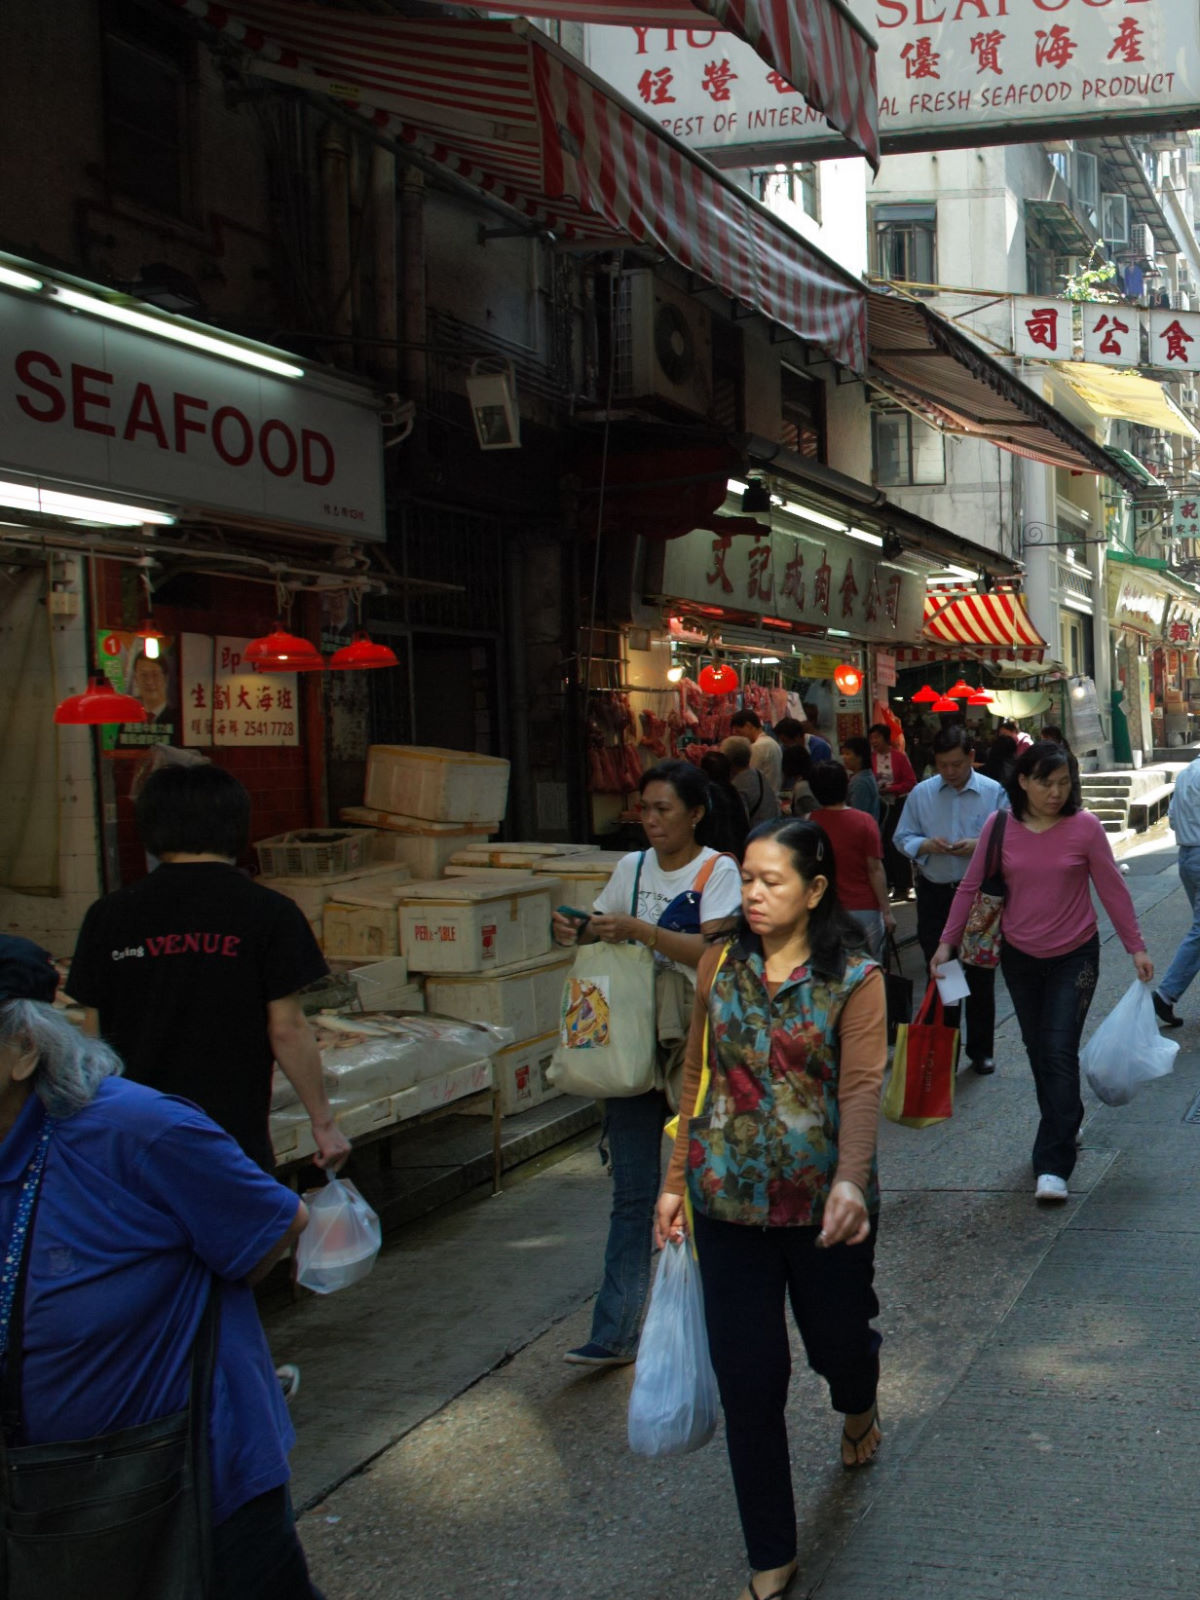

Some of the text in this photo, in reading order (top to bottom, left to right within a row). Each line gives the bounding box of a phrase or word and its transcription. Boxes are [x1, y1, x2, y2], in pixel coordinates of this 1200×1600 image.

[899, 17, 1145, 79] 優質海產
[713, 112, 738, 133] OF
[909, 89, 971, 114] FRESH
[981, 81, 1072, 107] SEAFOOD
[1082, 72, 1176, 102] PRODUCT
[15, 350, 335, 486] SEAFOOD
[145, 932, 241, 958] VENUE
